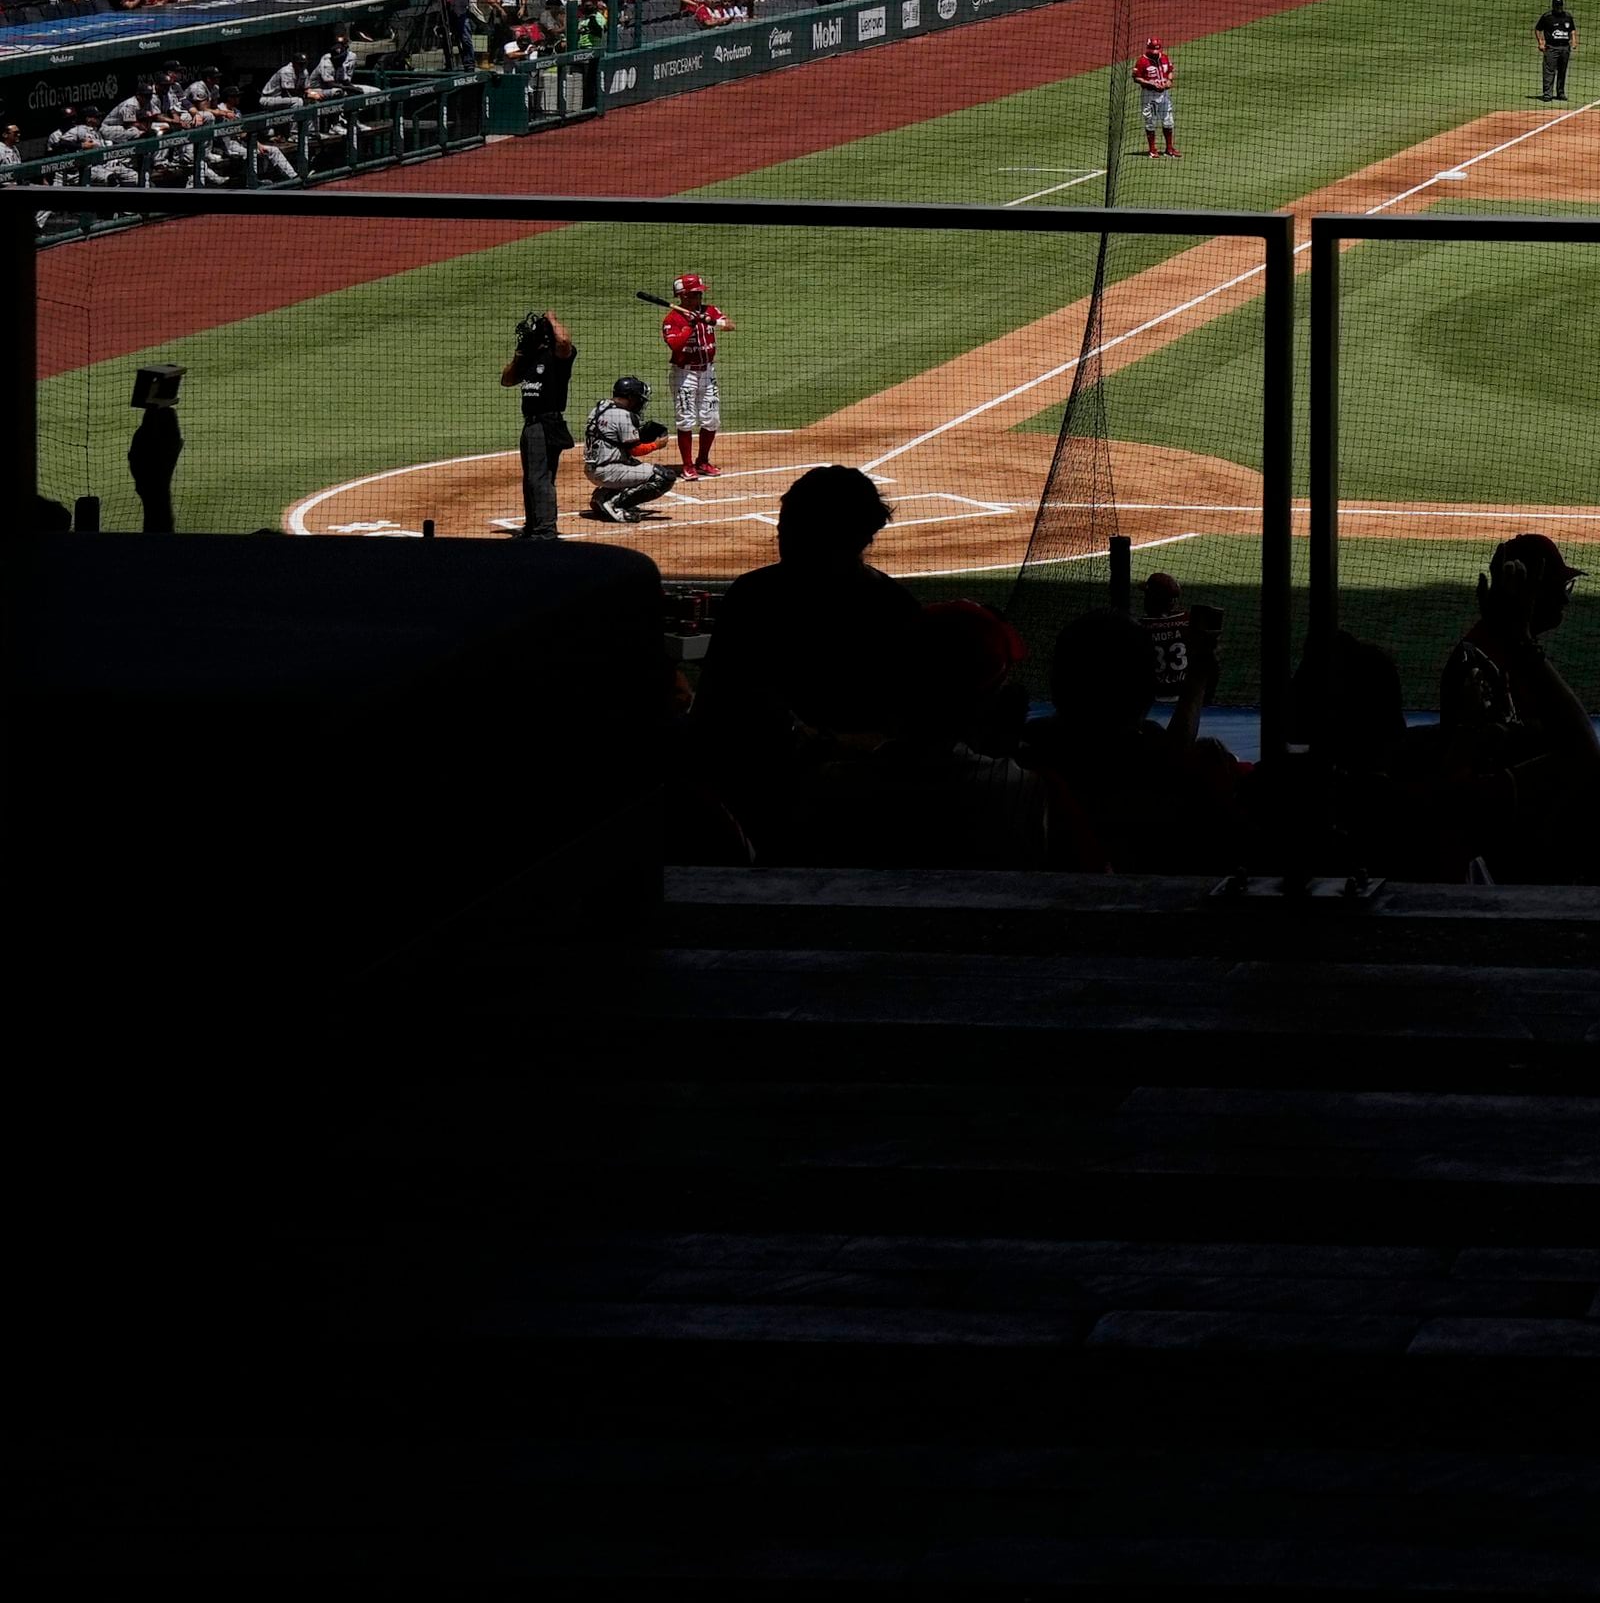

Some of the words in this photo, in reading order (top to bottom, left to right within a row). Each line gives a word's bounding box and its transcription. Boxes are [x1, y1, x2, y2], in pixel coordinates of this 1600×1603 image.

[812, 17, 842, 51] Mobil
[861, 16, 884, 33] Lenovo
[722, 44, 752, 62] Profuturo
[660, 54, 703, 79] INTERCERAMIC
